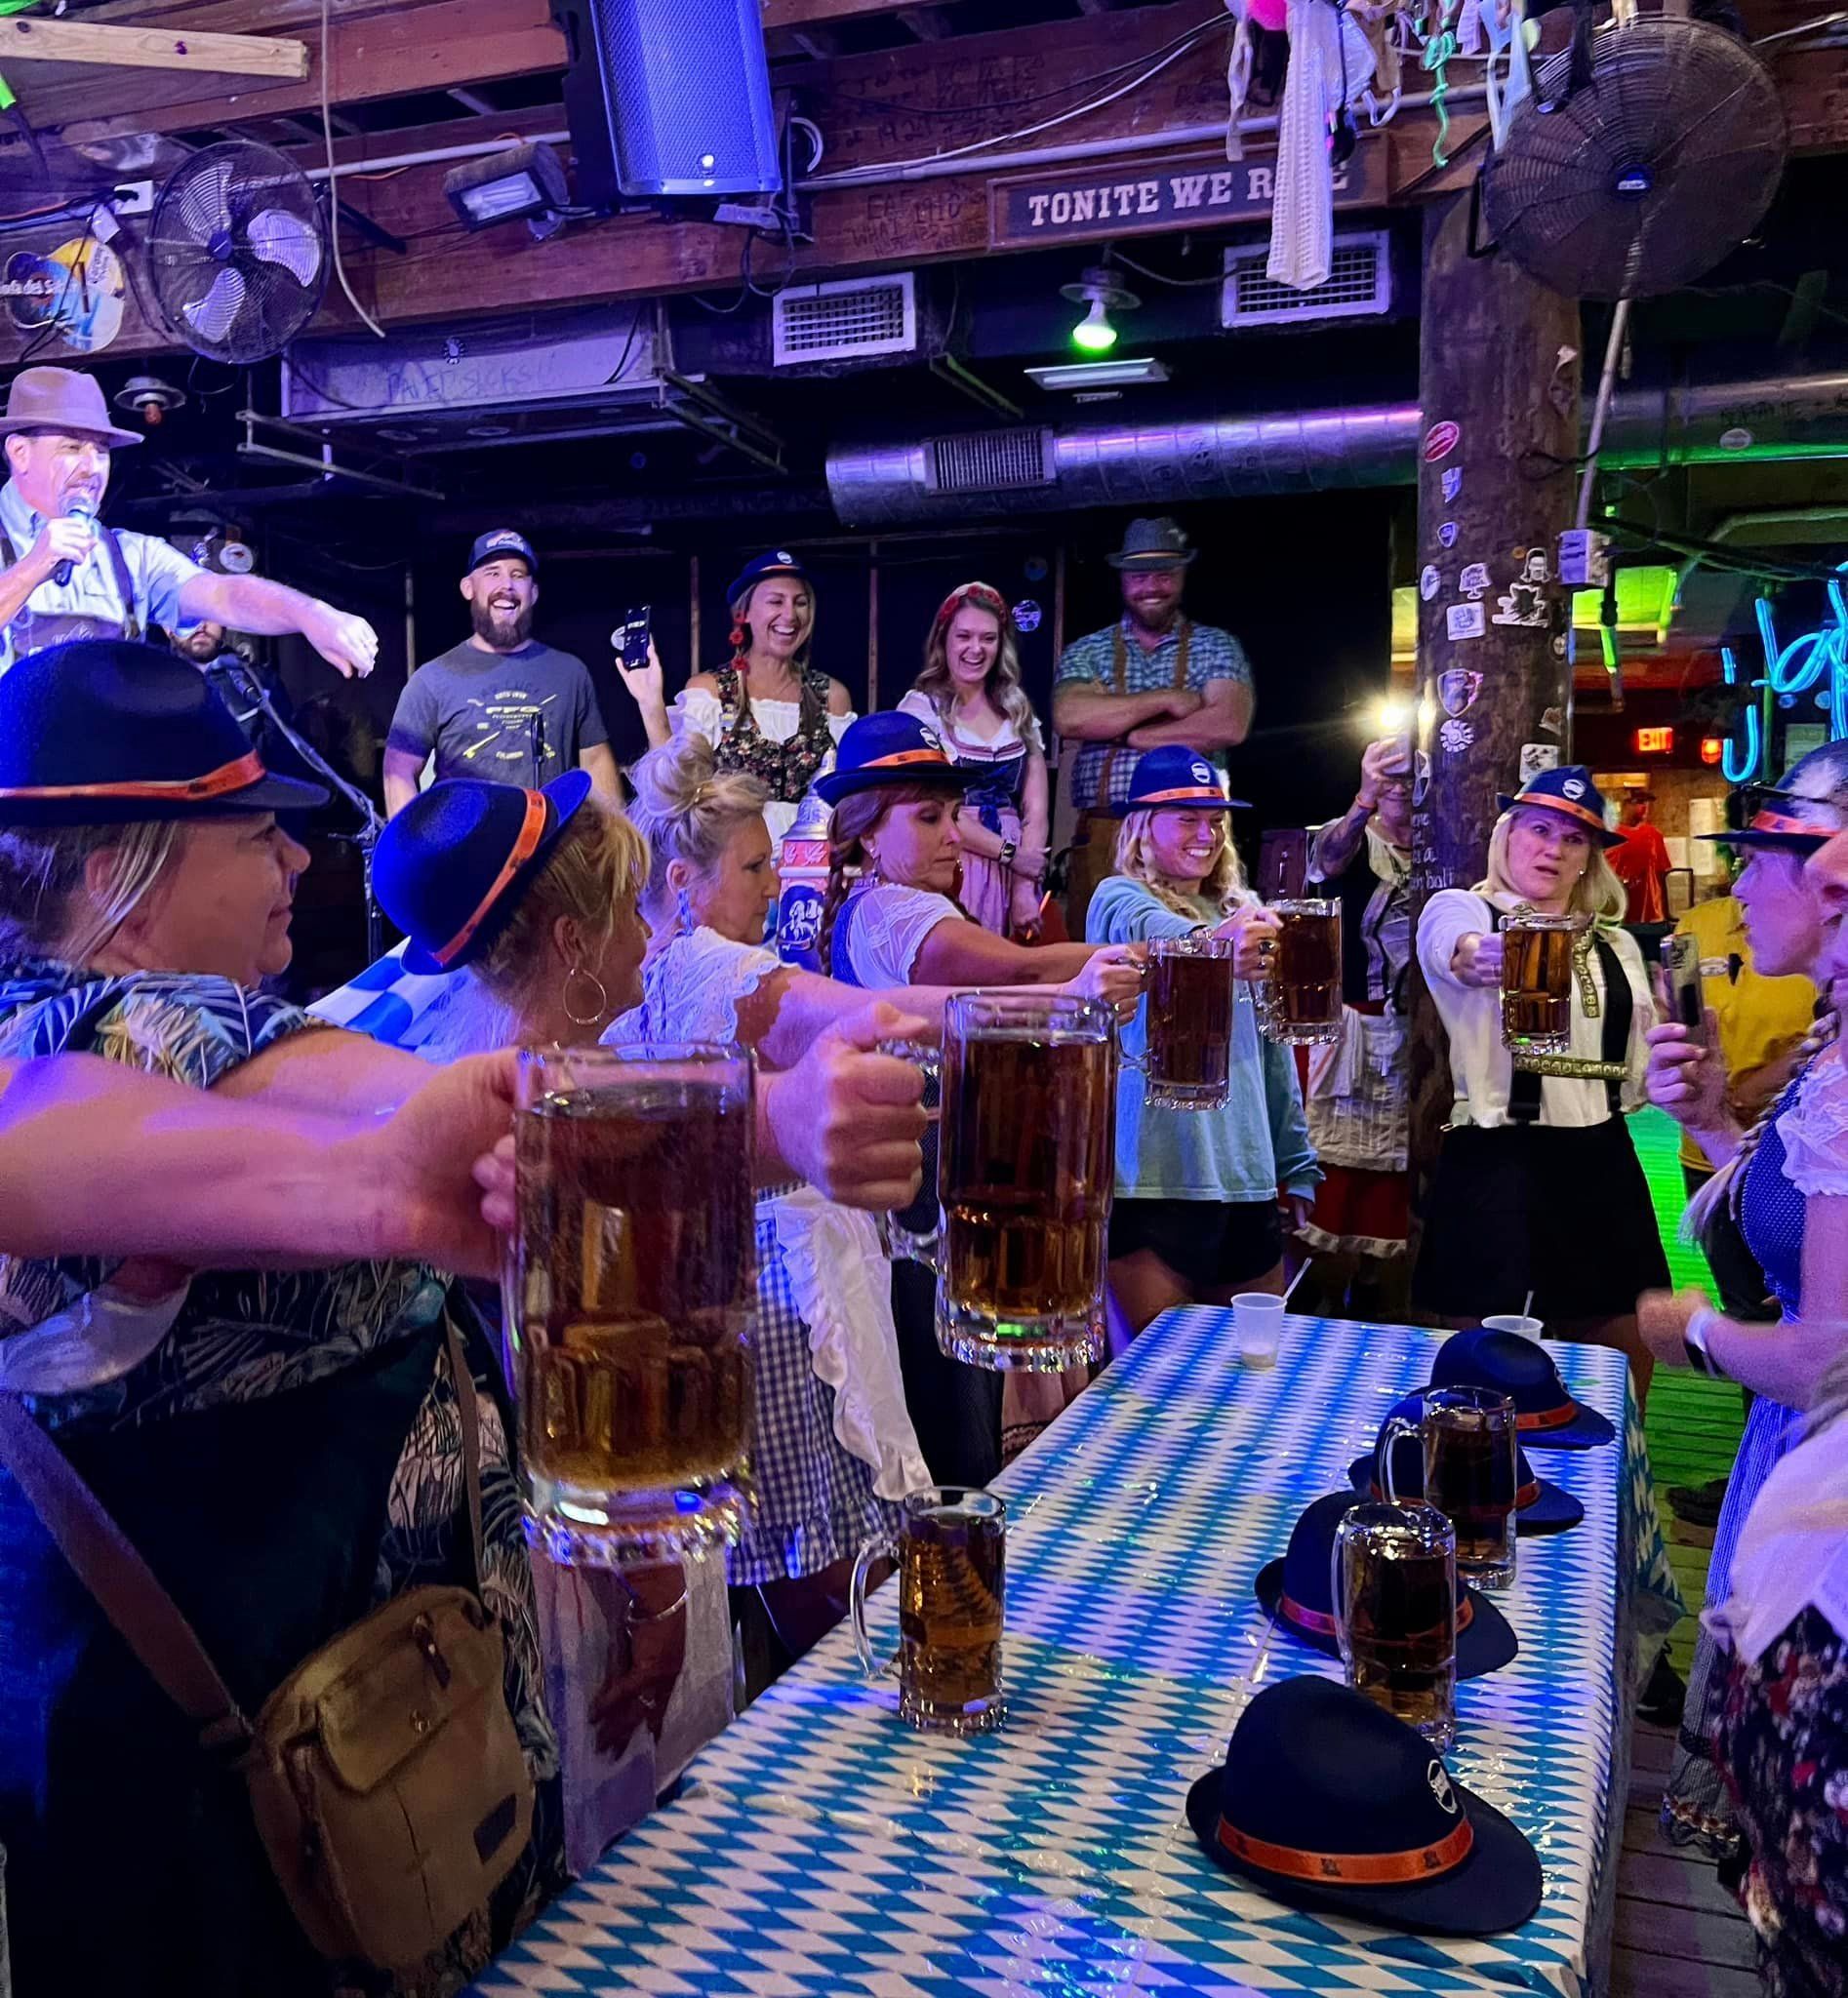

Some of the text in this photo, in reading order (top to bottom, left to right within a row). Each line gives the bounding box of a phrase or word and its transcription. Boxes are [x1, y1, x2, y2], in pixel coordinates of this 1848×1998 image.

[1028, 160, 1348, 226] TONITE WE RE
